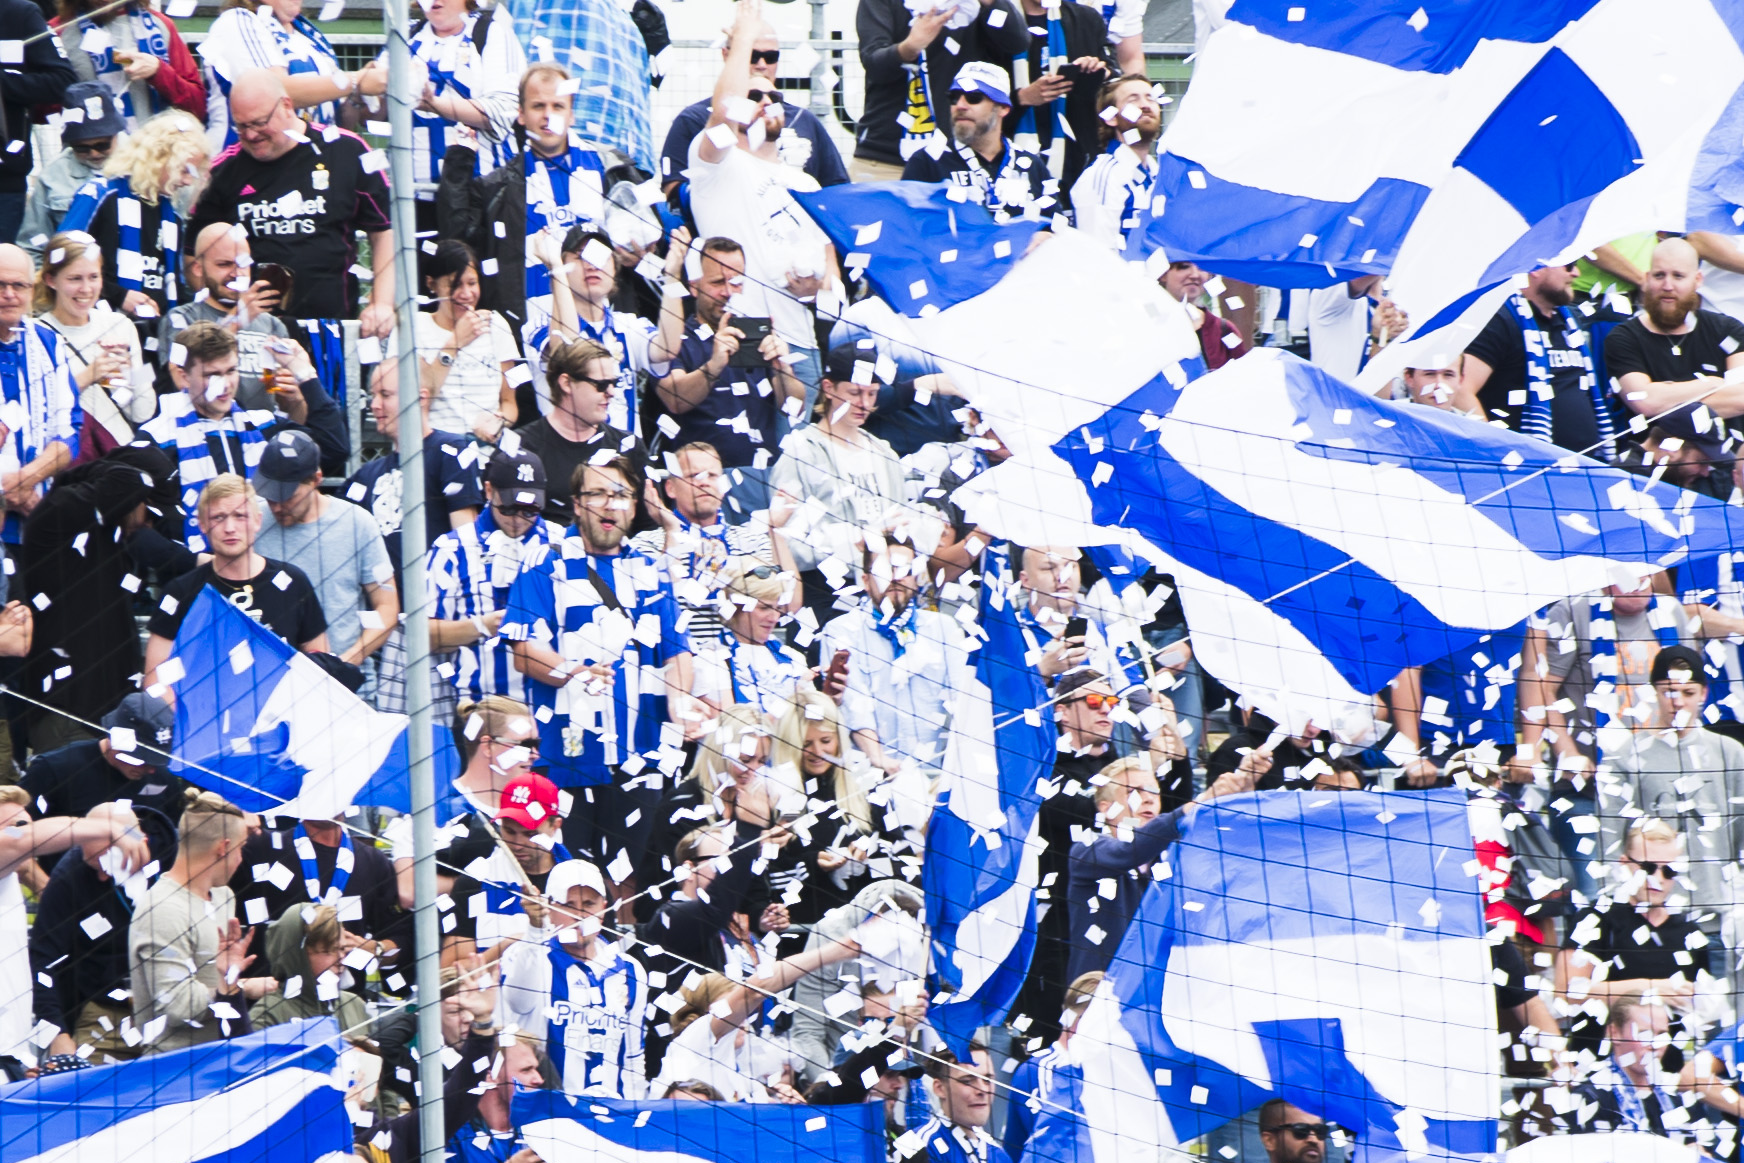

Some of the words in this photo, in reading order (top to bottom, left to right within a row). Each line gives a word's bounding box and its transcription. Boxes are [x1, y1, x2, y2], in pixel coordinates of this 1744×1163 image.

[238, 194, 327, 221] Prioet
[250, 217, 316, 237] Finans
[556, 1003, 629, 1030] Priorite
